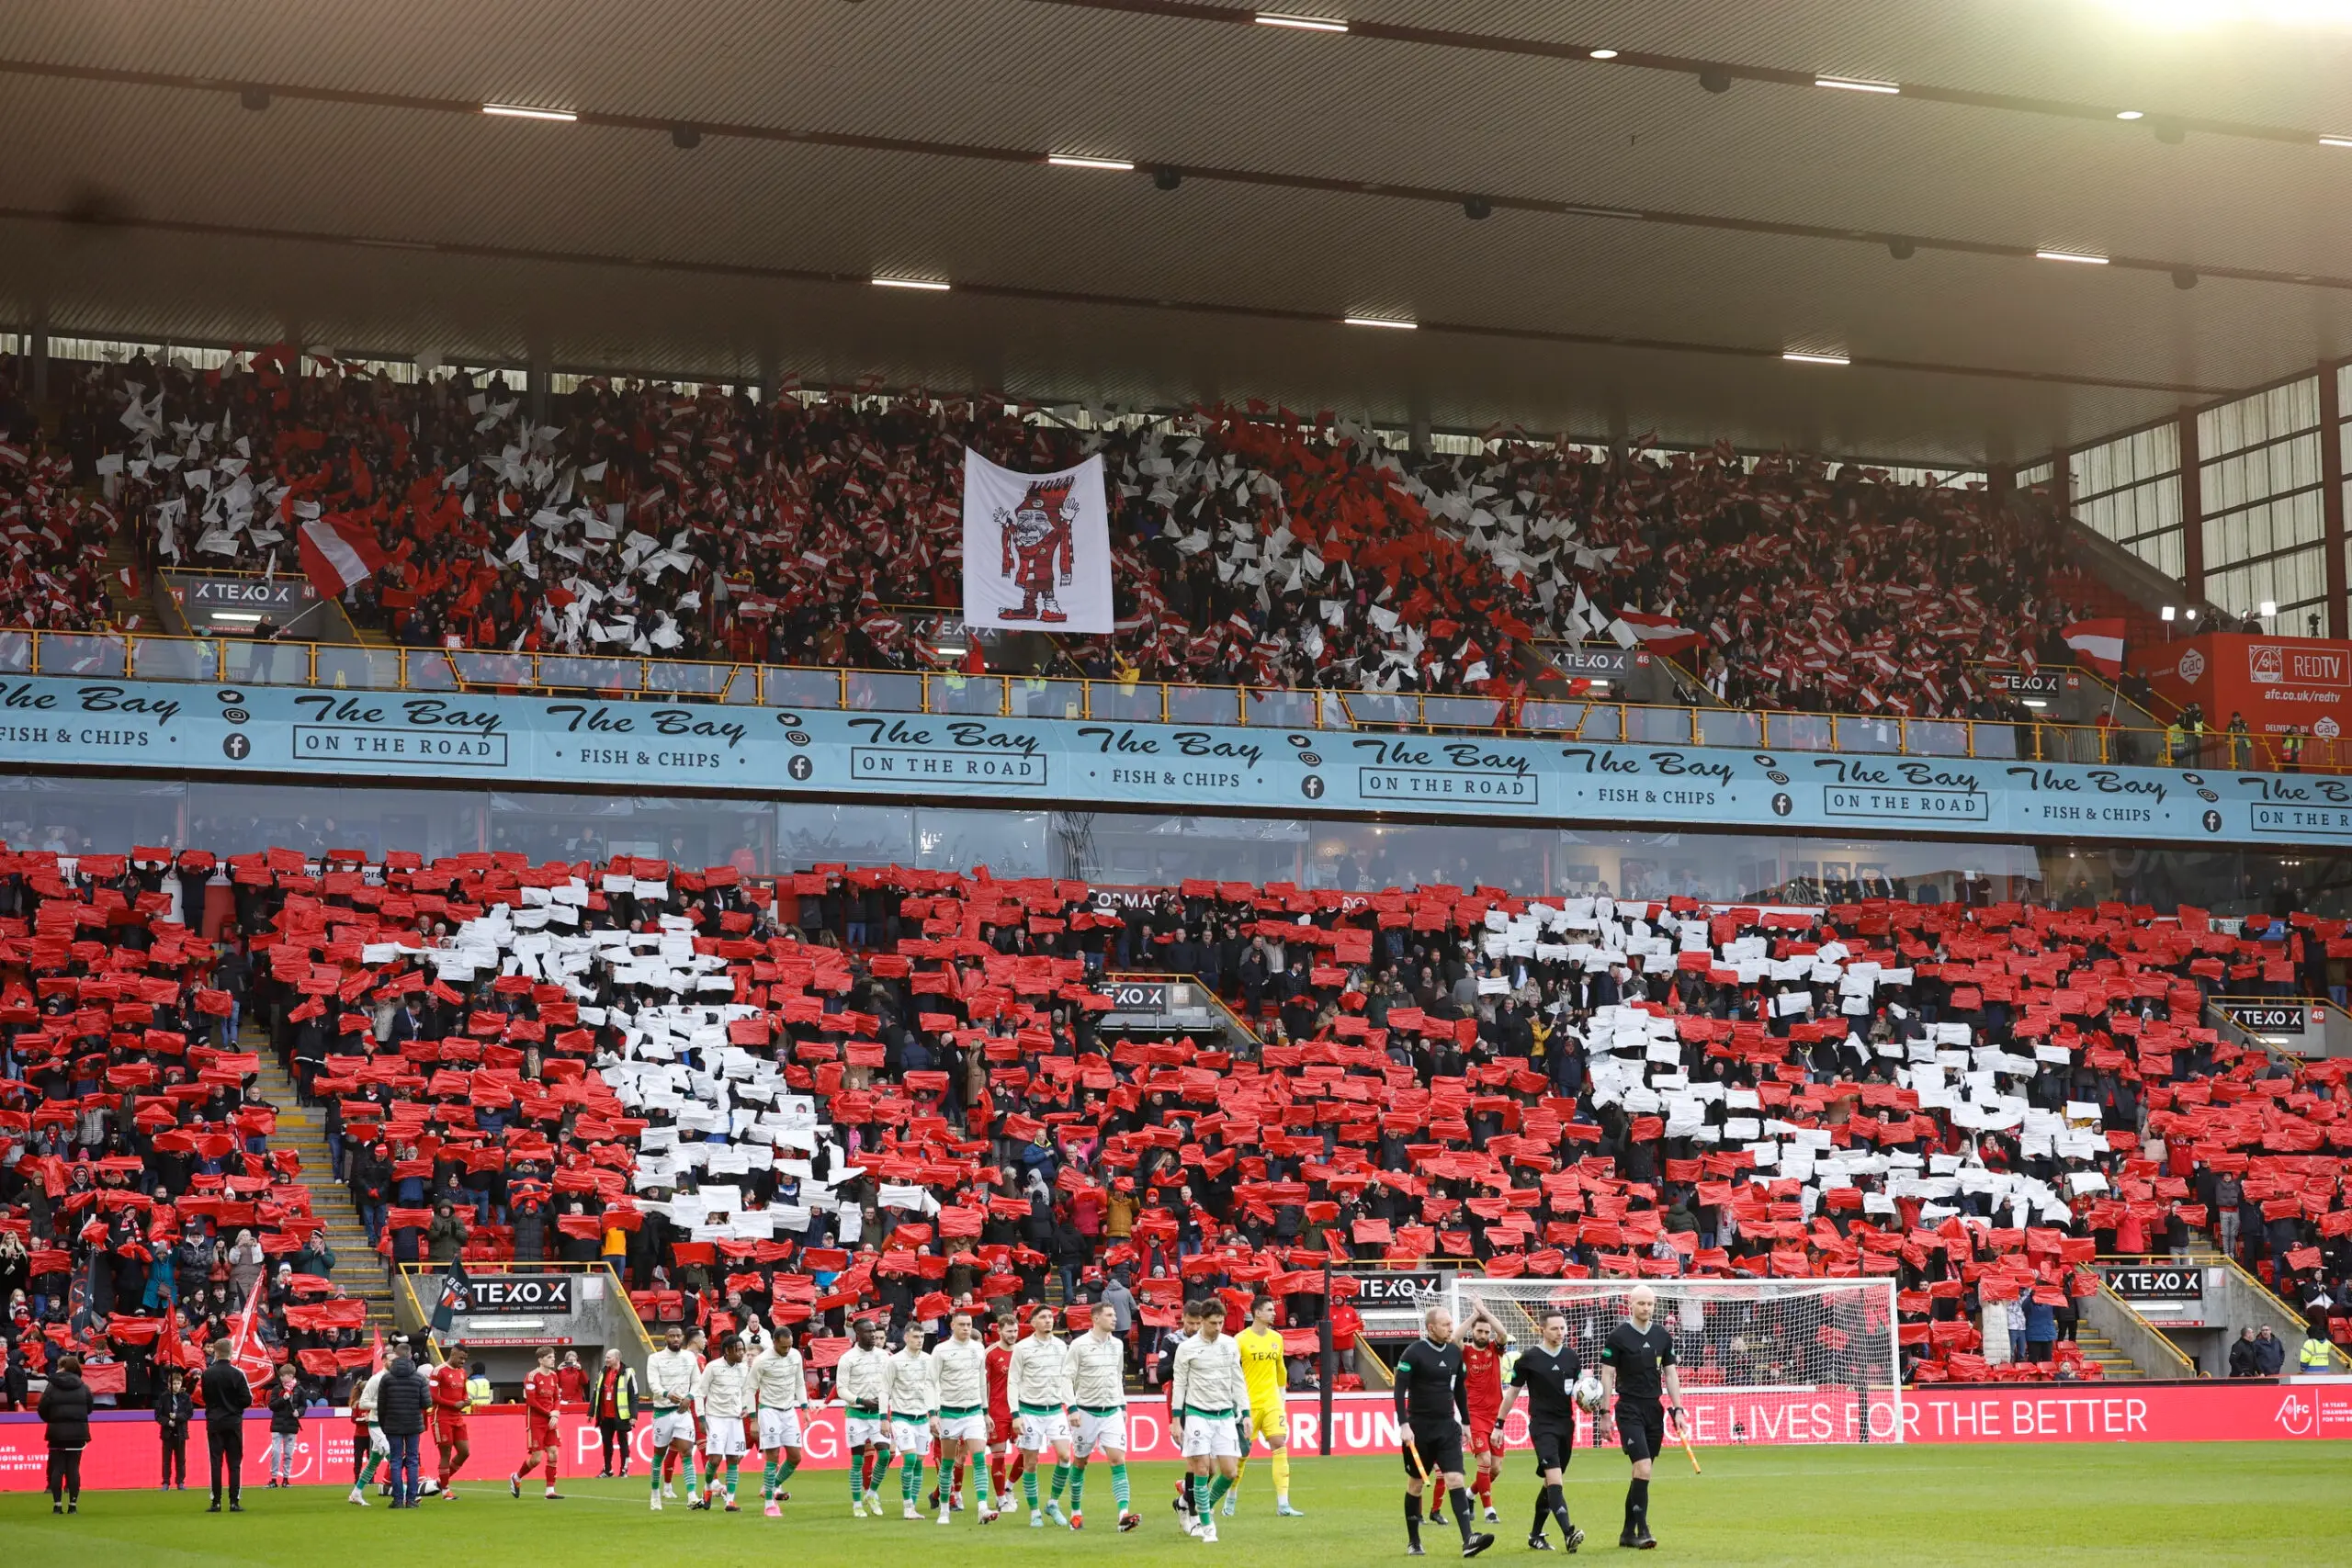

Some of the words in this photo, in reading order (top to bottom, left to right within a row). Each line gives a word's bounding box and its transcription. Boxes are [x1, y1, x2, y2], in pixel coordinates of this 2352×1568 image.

[214, 583, 270, 601] TEXO
[1566, 654, 1608, 669] TEXO
[1637, 654, 1649, 665] 46
[2067, 677, 2078, 686] 48
[2265, 689, 2341, 703] afc.co.uk/redtv
[77, 687, 182, 727] Bay
[294, 695, 384, 723] The
[402, 700, 502, 739] Bay
[547, 705, 635, 733] The
[650, 710, 747, 749] Bay
[2301, 725, 2309, 733] BY
[57, 728, 72, 743] &
[81, 730, 149, 746] CHIPS
[306, 736, 338, 750] ON
[355, 738, 404, 752] THE
[421, 740, 492, 756] ROAD
[848, 718, 933, 745] The
[946, 723, 1039, 760] Bay
[1078, 728, 1160, 754] The
[1173, 732, 1263, 769] Bay
[581, 750, 628, 764] FISH
[638, 752, 650, 765] &
[659, 752, 719, 768] CHIPS
[864, 757, 893, 771] ON
[908, 759, 953, 773] THE
[967, 761, 1032, 776] ROAD
[1353, 740, 1432, 765] The
[1443, 744, 1530, 778] Bay
[1562, 750, 1640, 773] The
[1649, 752, 1735, 786] Bay
[1113, 770, 1156, 784] FISH
[1164, 772, 1175, 785] &
[1183, 773, 1239, 787] CHIPS
[1370, 776, 1397, 790] ON
[1411, 778, 1452, 793] THE
[1464, 781, 1525, 795] ROAD
[1814, 760, 1889, 784] The
[1897, 763, 1979, 795] Bay
[2007, 767, 2080, 792] The
[2087, 772, 2166, 804] Bay
[1599, 788, 1638, 802] FISH
[1646, 790, 1657, 803] &
[1664, 791, 1715, 805] CHIPS
[2238, 777, 2310, 800] The
[1834, 795, 1858, 807] ON
[1871, 796, 1909, 809] THE
[1922, 797, 1975, 812] ROAD
[2043, 806, 2080, 819] FISH
[2086, 807, 2097, 820] &
[2103, 808, 2151, 822] CHIPS
[2260, 811, 2284, 824] ON
[2293, 813, 2330, 826] THE
[2243, 1010, 2287, 1026] TEXO
[2312, 1010, 2324, 1021] 49
[1360, 1278, 1416, 1298] TEXO
[2128, 1272, 2180, 1291] TEXO
[472, 1282, 541, 1303] TEXO
[1251, 1352, 1278, 1361] TEXO
[1730, 1403, 1833, 1440] LIVES
[1845, 1402, 1920, 1438] FOR
[1928, 1401, 2001, 1436] THE
[2012, 1398, 2147, 1435] BETTER
